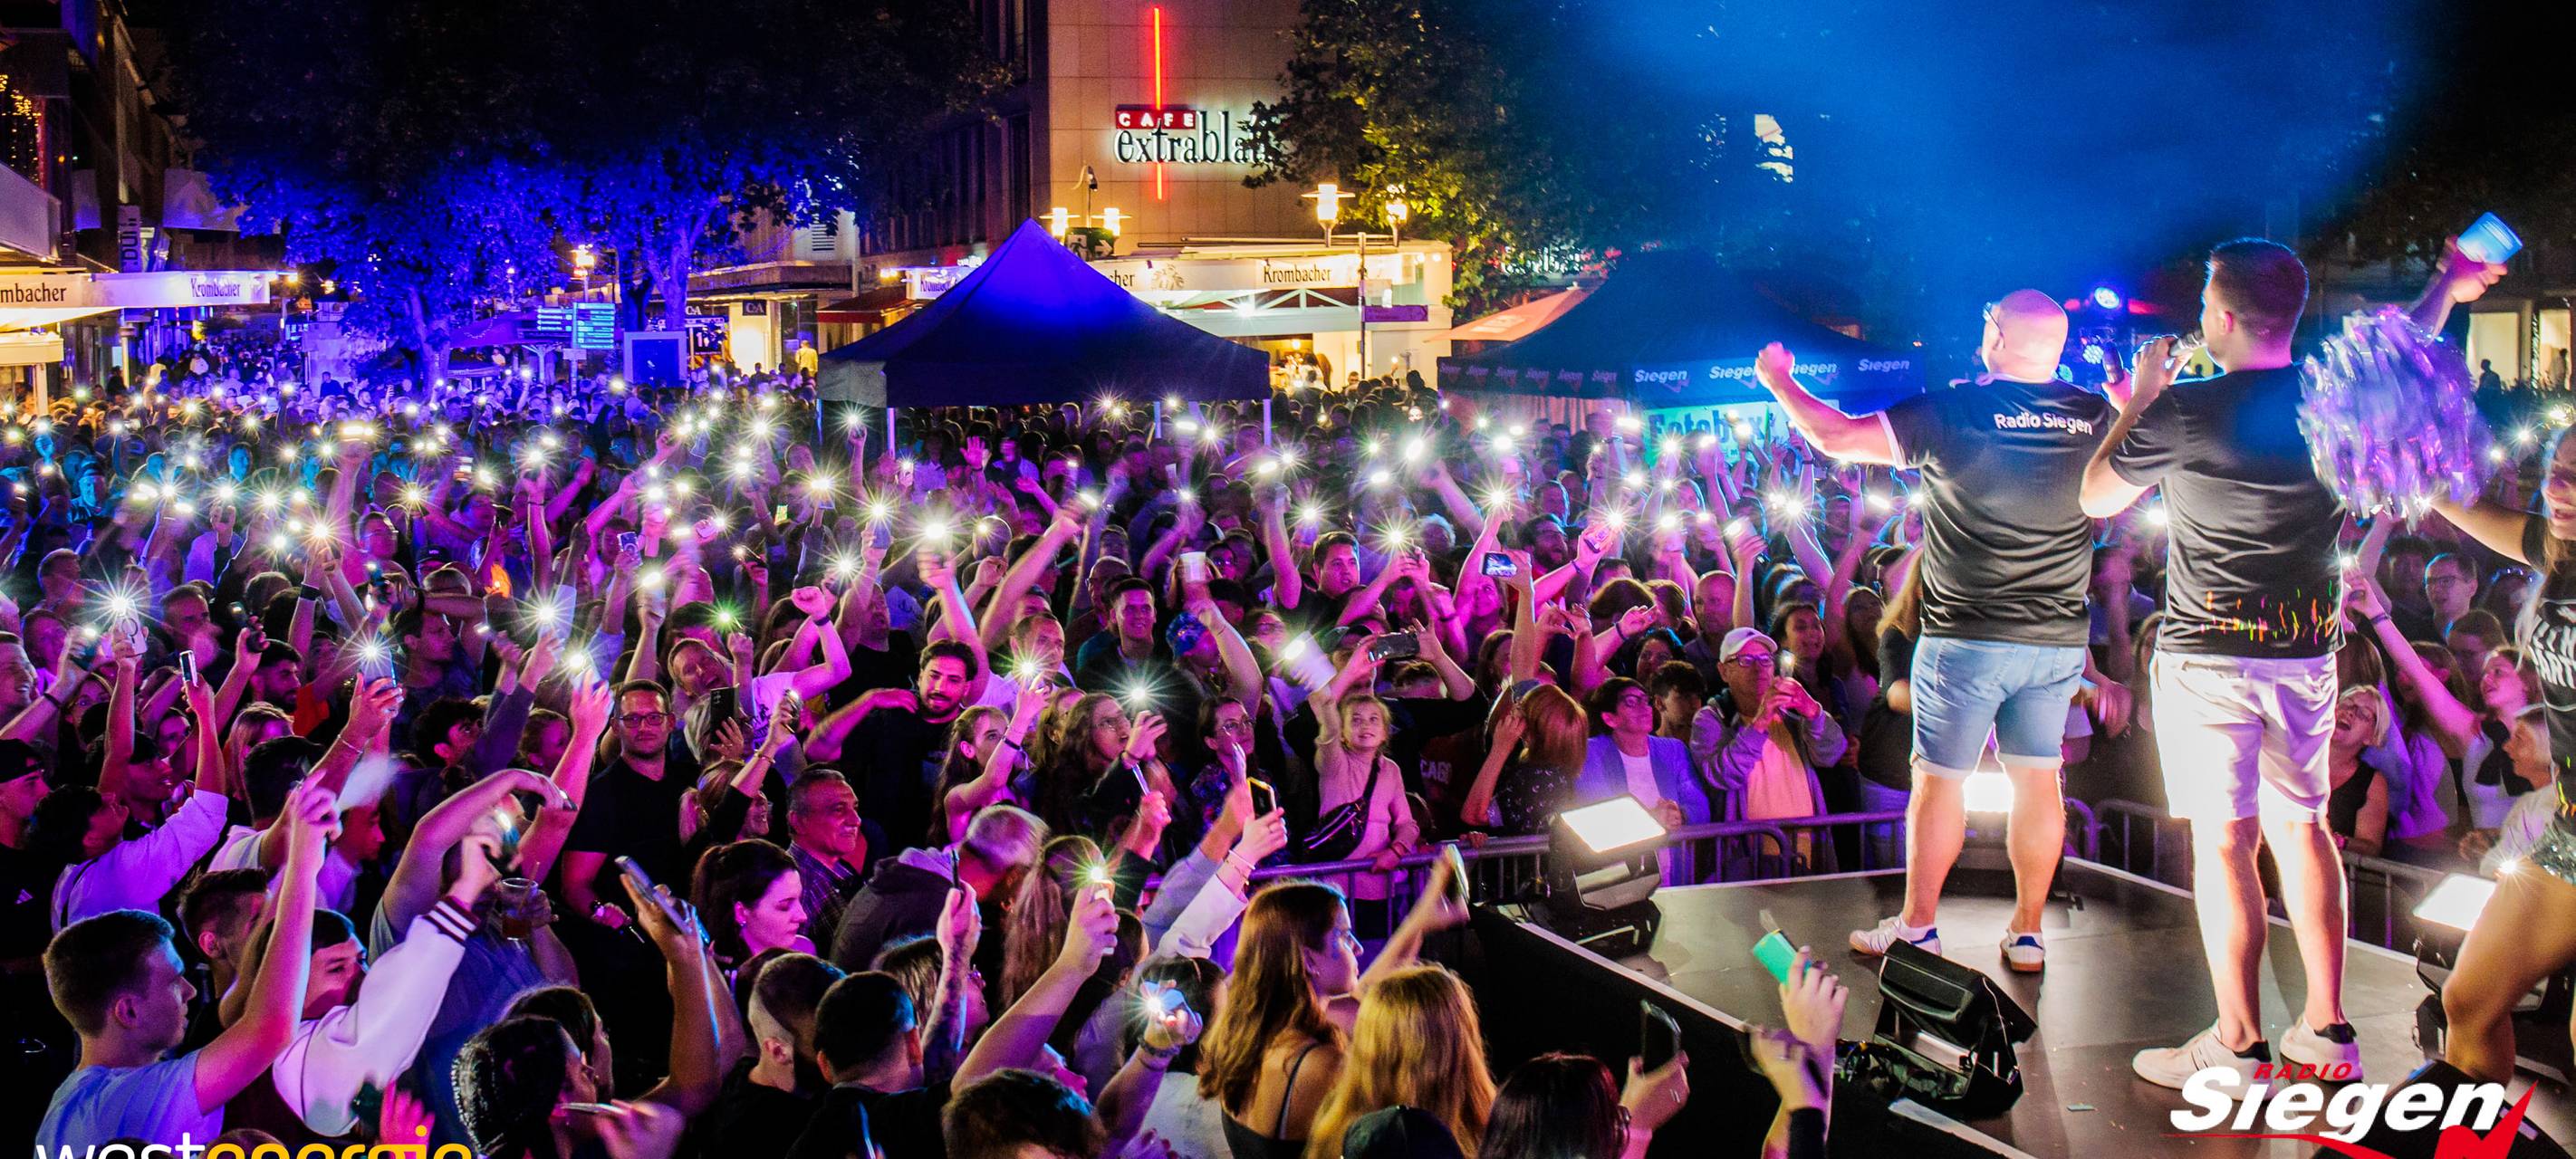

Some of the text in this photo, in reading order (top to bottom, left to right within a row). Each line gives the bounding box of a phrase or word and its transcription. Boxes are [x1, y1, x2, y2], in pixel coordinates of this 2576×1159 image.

[1118, 112, 1194, 128] CAFE
[1264, 265, 1331, 283] Krombacher
[1709, 365, 1757, 380] Siege
[1792, 361, 1838, 377] iegen
[1858, 358, 1910, 372] Siegen
[1634, 369, 1688, 384] Siegen
[1648, 409, 1766, 447] Fotobx
[1994, 411, 2093, 435] Radio Siegen
